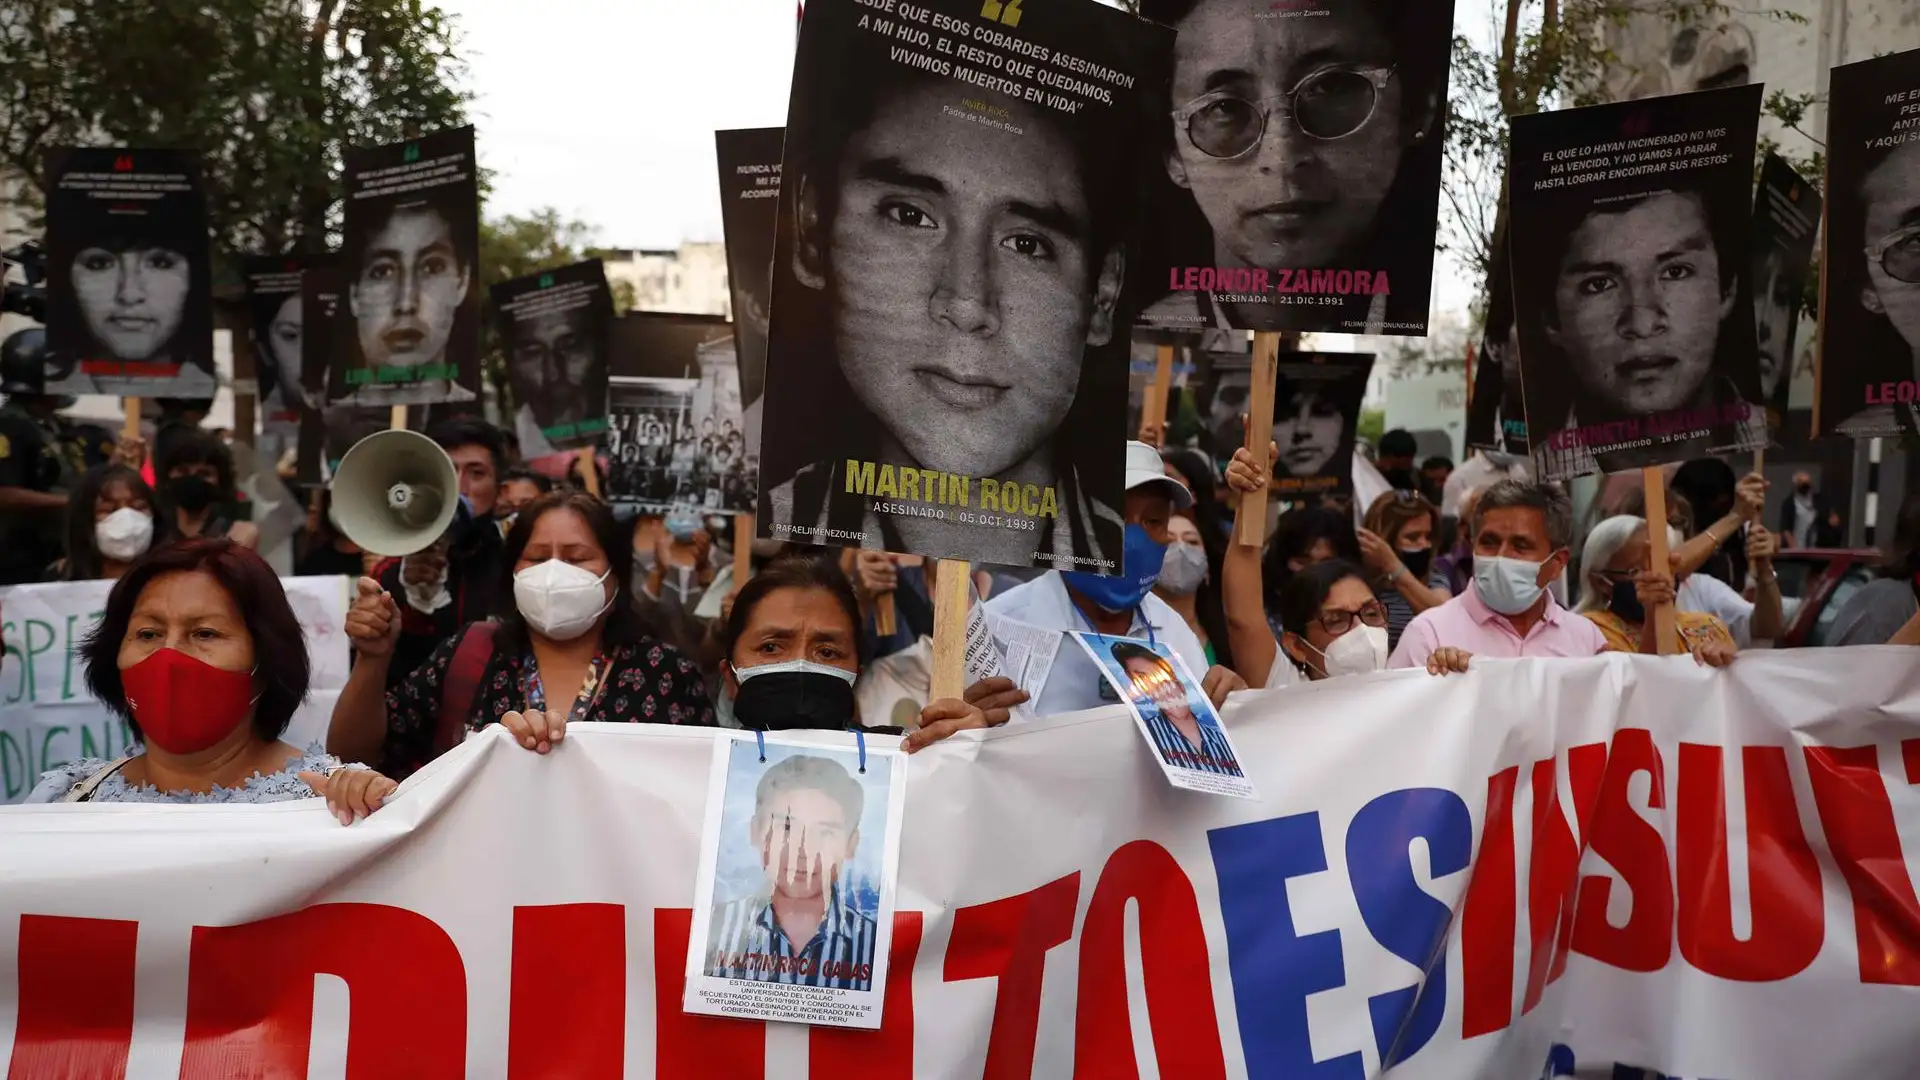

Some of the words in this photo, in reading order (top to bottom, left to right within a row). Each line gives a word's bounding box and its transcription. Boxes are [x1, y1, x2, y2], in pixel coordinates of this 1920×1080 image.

[1279, 10, 1302, 18] Leonor
[1303, 9, 1330, 17] Zamora
[899, 4, 929, 24] QUE
[932, 12, 970, 36] ESOS
[973, 26, 1049, 62] COBARDES
[1051, 51, 1135, 89] ASESINARON
[858, 14, 870, 28] A
[873, 19, 893, 36] MI
[896, 25, 932, 50] HIJO,
[936, 38, 954, 54] EL
[956, 43, 1002, 69] RESTO
[1006, 58, 1034, 78] QUE
[1036, 68, 1114, 106] QUEDAMOS,
[890, 46, 950, 76] VIVIMOS
[953, 65, 1022, 98] MUERTOS
[1024, 88, 1044, 106] EN
[962, 98, 986, 113] JAVIER
[988, 106, 1011, 118] ROCA
[1885, 92, 1907, 104] ME
[943, 105, 966, 120] Padre
[967, 114, 977, 122] de
[1004, 120, 1024, 135] Roca
[1543, 152, 1554, 162] EL
[1556, 148, 1577, 161] QUE
[1579, 146, 1592, 156] LO
[1594, 141, 1625, 153] HAYAN
[1628, 133, 1688, 149] INCINERADO
[1690, 131, 1704, 140] NO
[1706, 127, 1726, 138] NOS
[1865, 139, 1873, 149] Y
[1551, 164, 1564, 175] HA
[1567, 158, 1611, 172] VENCIDO,
[1614, 156, 1621, 165] Y
[1623, 153, 1636, 163] NO
[1638, 148, 1673, 162] VAMOS
[1675, 147, 1681, 155] A
[1684, 142, 1717, 155] PARAR
[737, 165, 770, 174] NUNCA
[1534, 178, 1565, 191] HASTA
[1567, 171, 1606, 185] LOGRAR
[1608, 163, 1666, 180] ENCONTRAR
[1669, 159, 1688, 171] SUS
[755, 177, 768, 185] MI
[1169, 267, 1270, 291] LEONOR
[1277, 268, 1391, 296] ZAMORA
[1212, 294, 1268, 304] ASESINADA
[1865, 380, 1920, 404] LEO
[1547, 419, 1640, 451] KENNETH
[844, 459, 970, 508] MARTIN
[980, 478, 1059, 519] ROCA
[873, 501, 945, 520] ASESINADO
[2, 611, 108, 706] SPE
[729, 980, 773, 990] ESTUDIANTE
[786, 985, 824, 994] ECONOMIA
[741, 988, 789, 998] UNIVERSIDAD
[805, 993, 833, 1002] CALLAO
[699, 990, 753, 1000] SECUESTRADO
[764, 996, 800, 1005] 05/10/1993
[807, 1000, 850, 1010] CONDUCIDO
[706, 998, 750, 1007] TORTURADO
[751, 1002, 792, 1011] ASESINADO
[800, 1006, 843, 1016] INCINERADO
[721, 1006, 759, 1014] GOBIERNO
[772, 1010, 806, 1019] FUJIMORI
